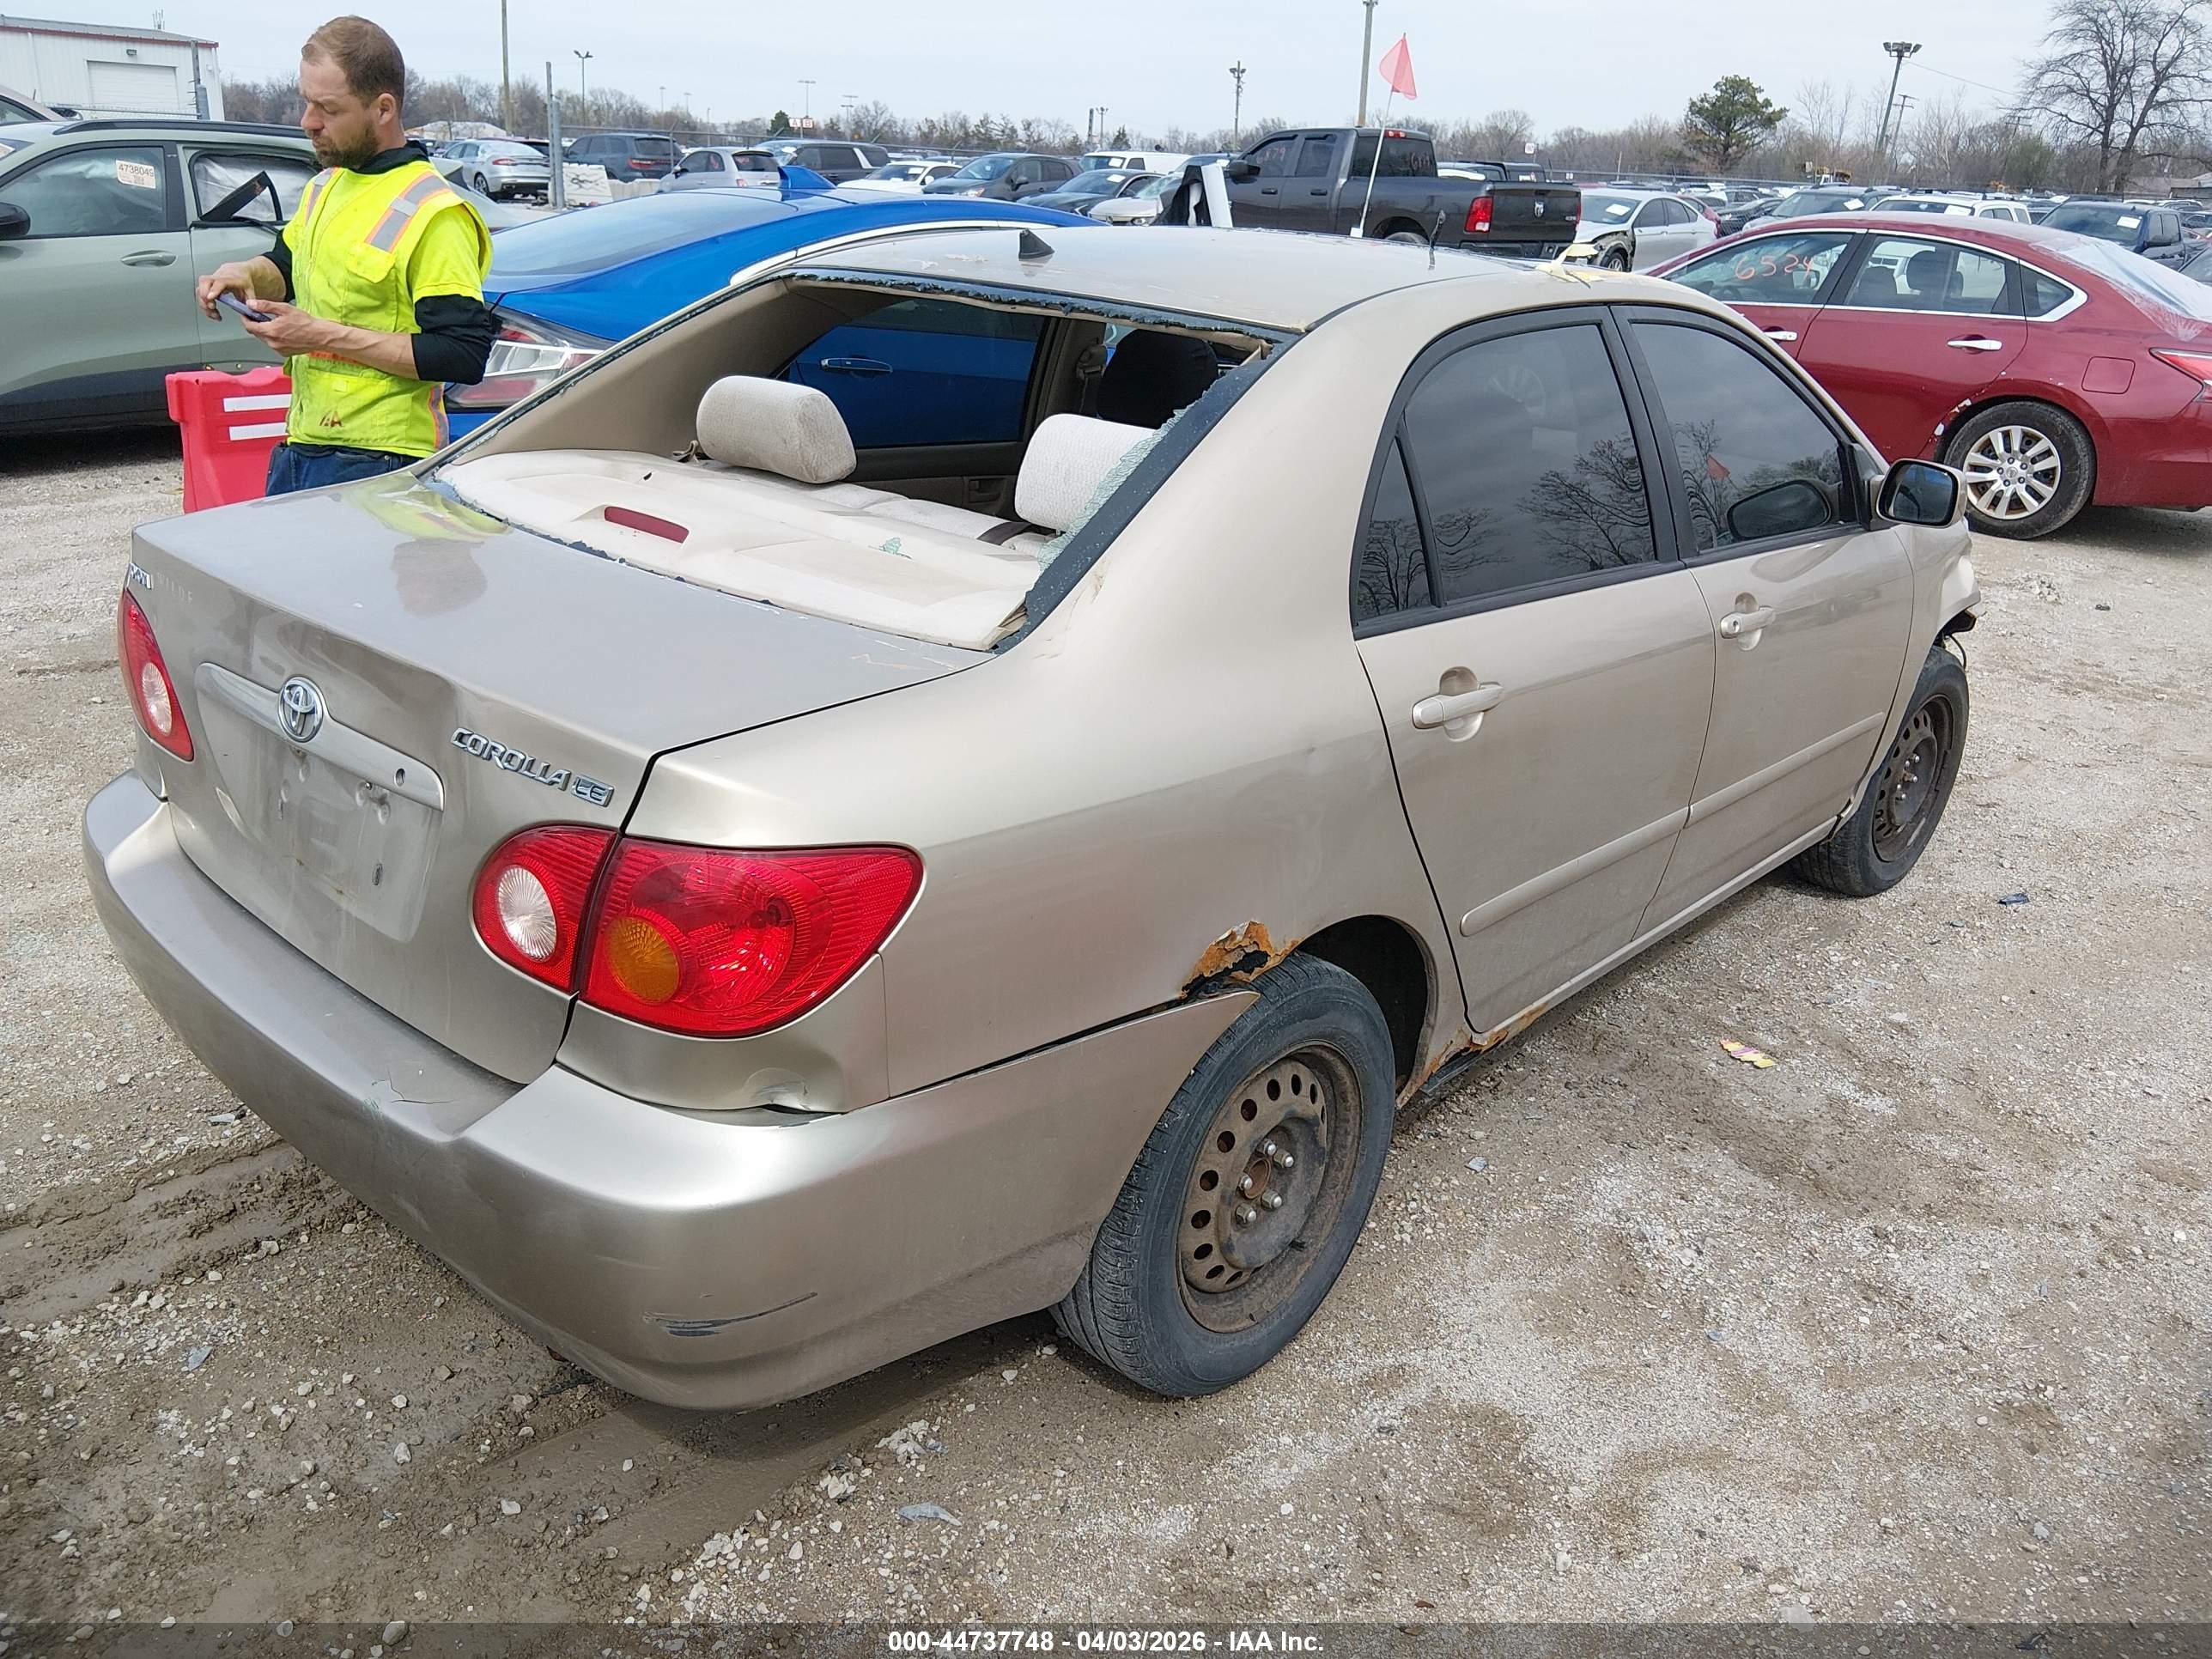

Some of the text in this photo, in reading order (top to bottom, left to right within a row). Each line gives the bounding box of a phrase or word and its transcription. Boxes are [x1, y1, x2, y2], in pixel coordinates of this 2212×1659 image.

[1735, 253, 1814, 280] 6524
[451, 727, 611, 805] COROLLA LE
